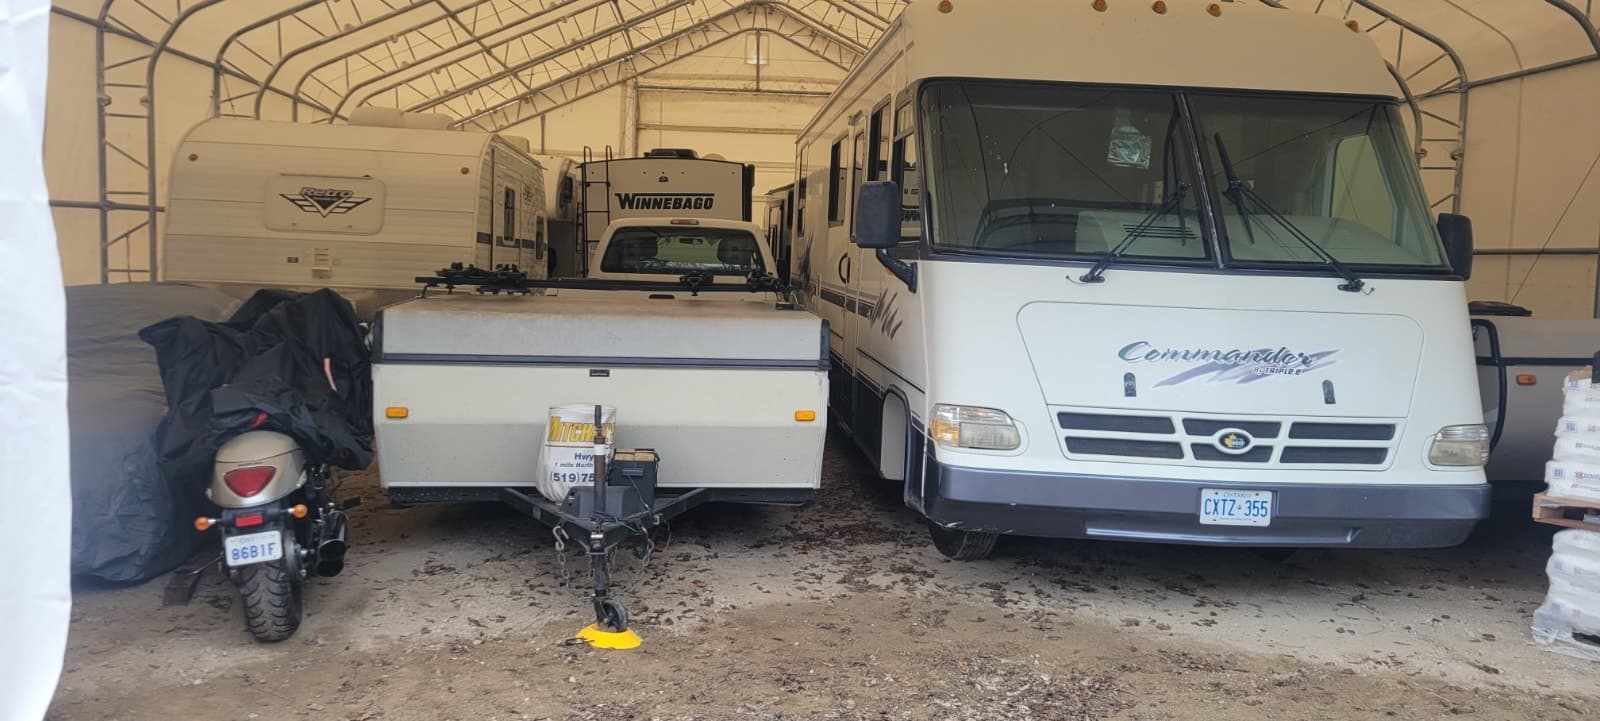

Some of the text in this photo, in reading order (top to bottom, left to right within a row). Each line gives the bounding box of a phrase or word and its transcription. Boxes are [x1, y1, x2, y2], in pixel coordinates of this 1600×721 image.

[615, 193, 715, 210] WINNEBAGO
[1118, 340, 1313, 367] Commander
[574, 453, 594, 461] Hwy
[1204, 498, 1268, 518] CXTZ 355
